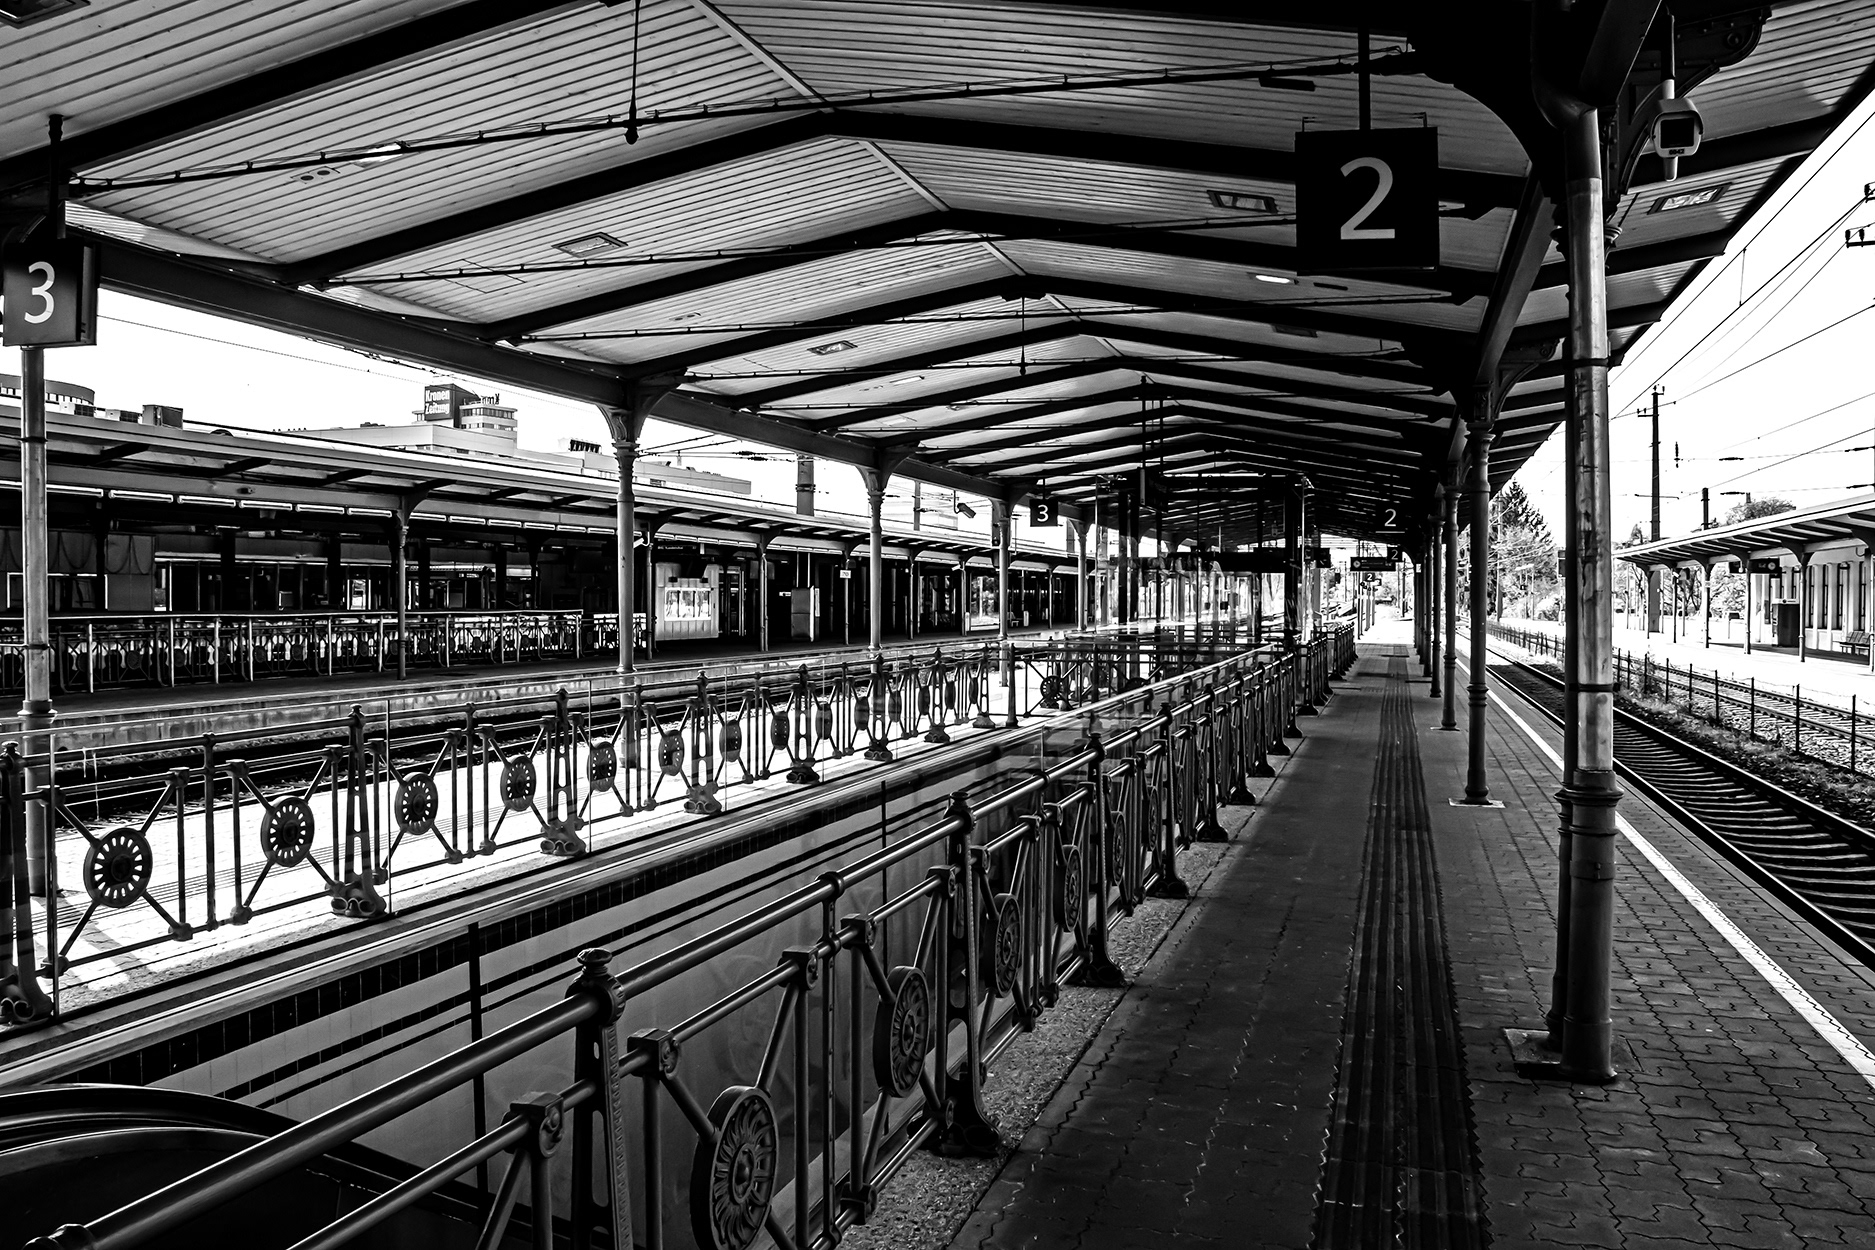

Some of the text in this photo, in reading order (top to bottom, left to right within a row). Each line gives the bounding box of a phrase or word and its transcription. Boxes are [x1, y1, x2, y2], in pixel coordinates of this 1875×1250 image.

[1340, 156, 1396, 240] 2
[24, 261, 55, 324] 3
[425, 389, 450, 402] Kronen
[425, 402, 450, 415] Zeitung
[1037, 504, 1049, 522] 3
[1384, 508, 1397, 527] 2
[1391, 549, 1399, 560] 2
[1367, 573, 1373, 581] 2
